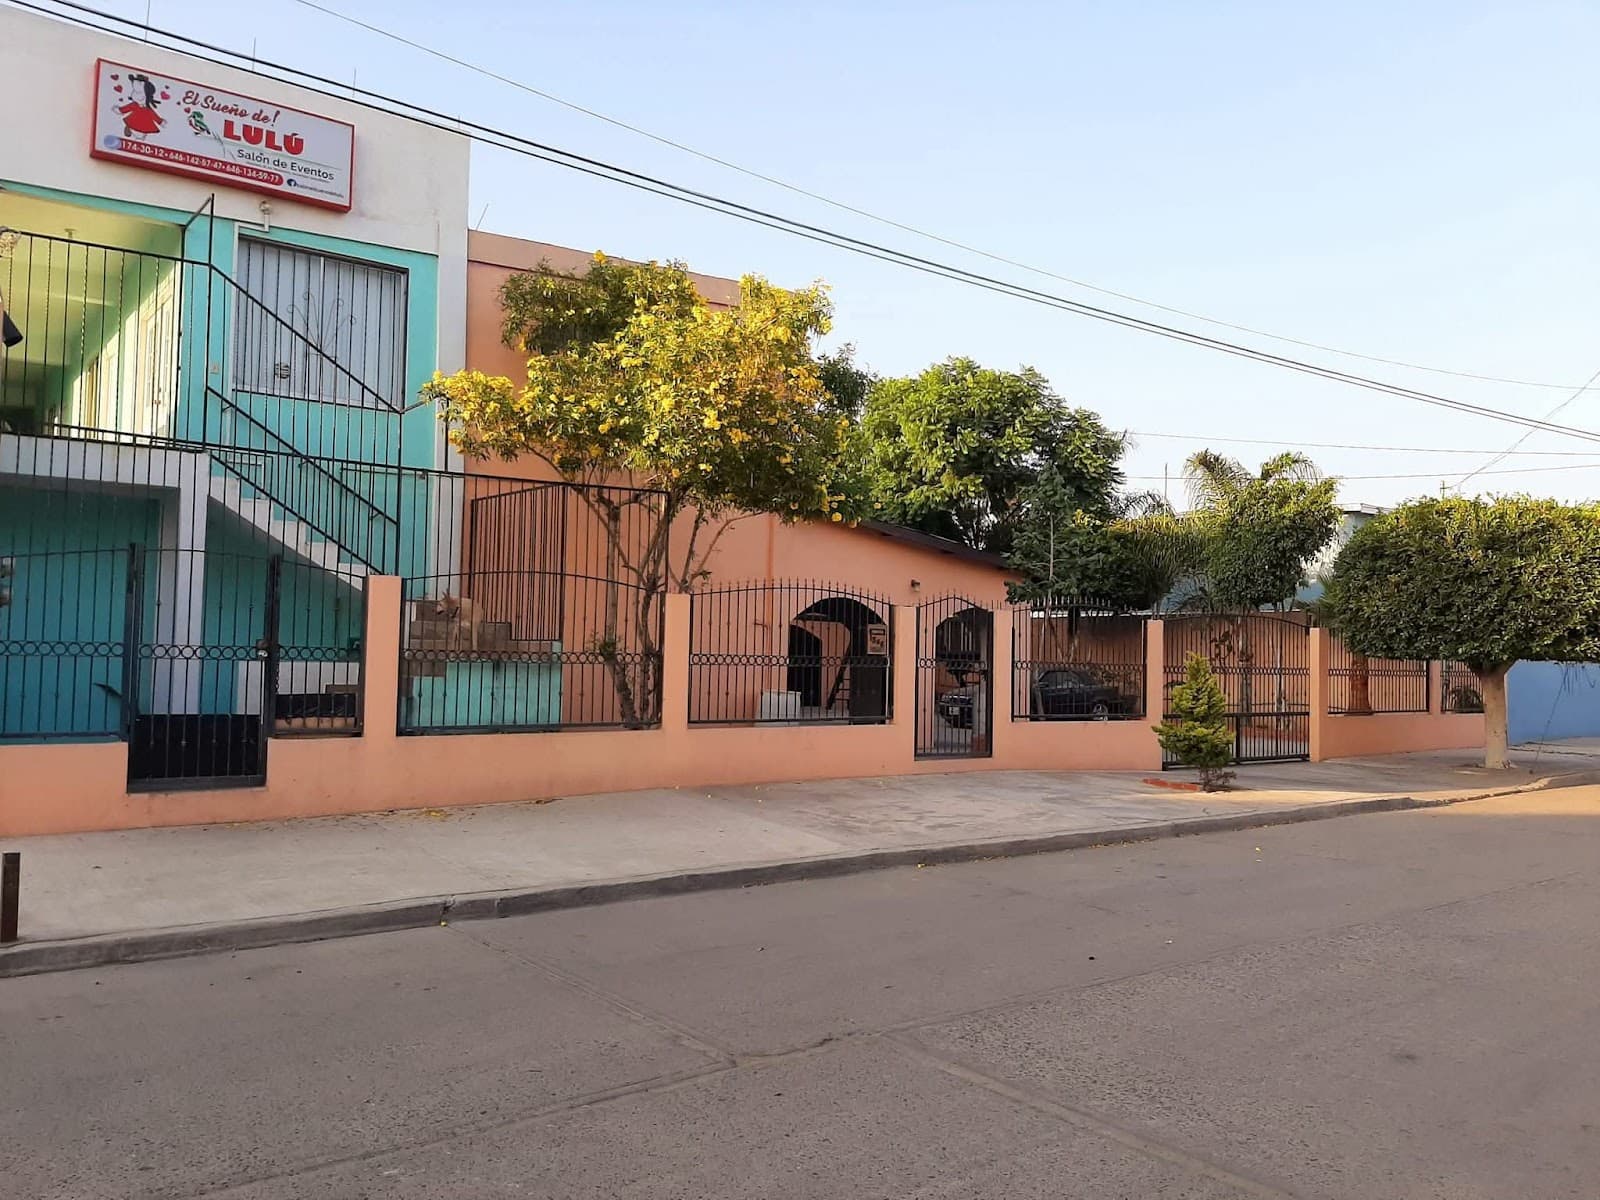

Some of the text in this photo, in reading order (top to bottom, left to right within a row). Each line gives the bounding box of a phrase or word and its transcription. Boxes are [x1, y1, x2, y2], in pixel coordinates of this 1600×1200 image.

[182, 90, 200, 106] El
[200, 95, 249, 118] Sueño
[223, 119, 304, 155] LULÚ
[237, 149, 270, 165] Salón
[272, 158, 288, 169] de
[290, 162, 335, 181] Eventos
